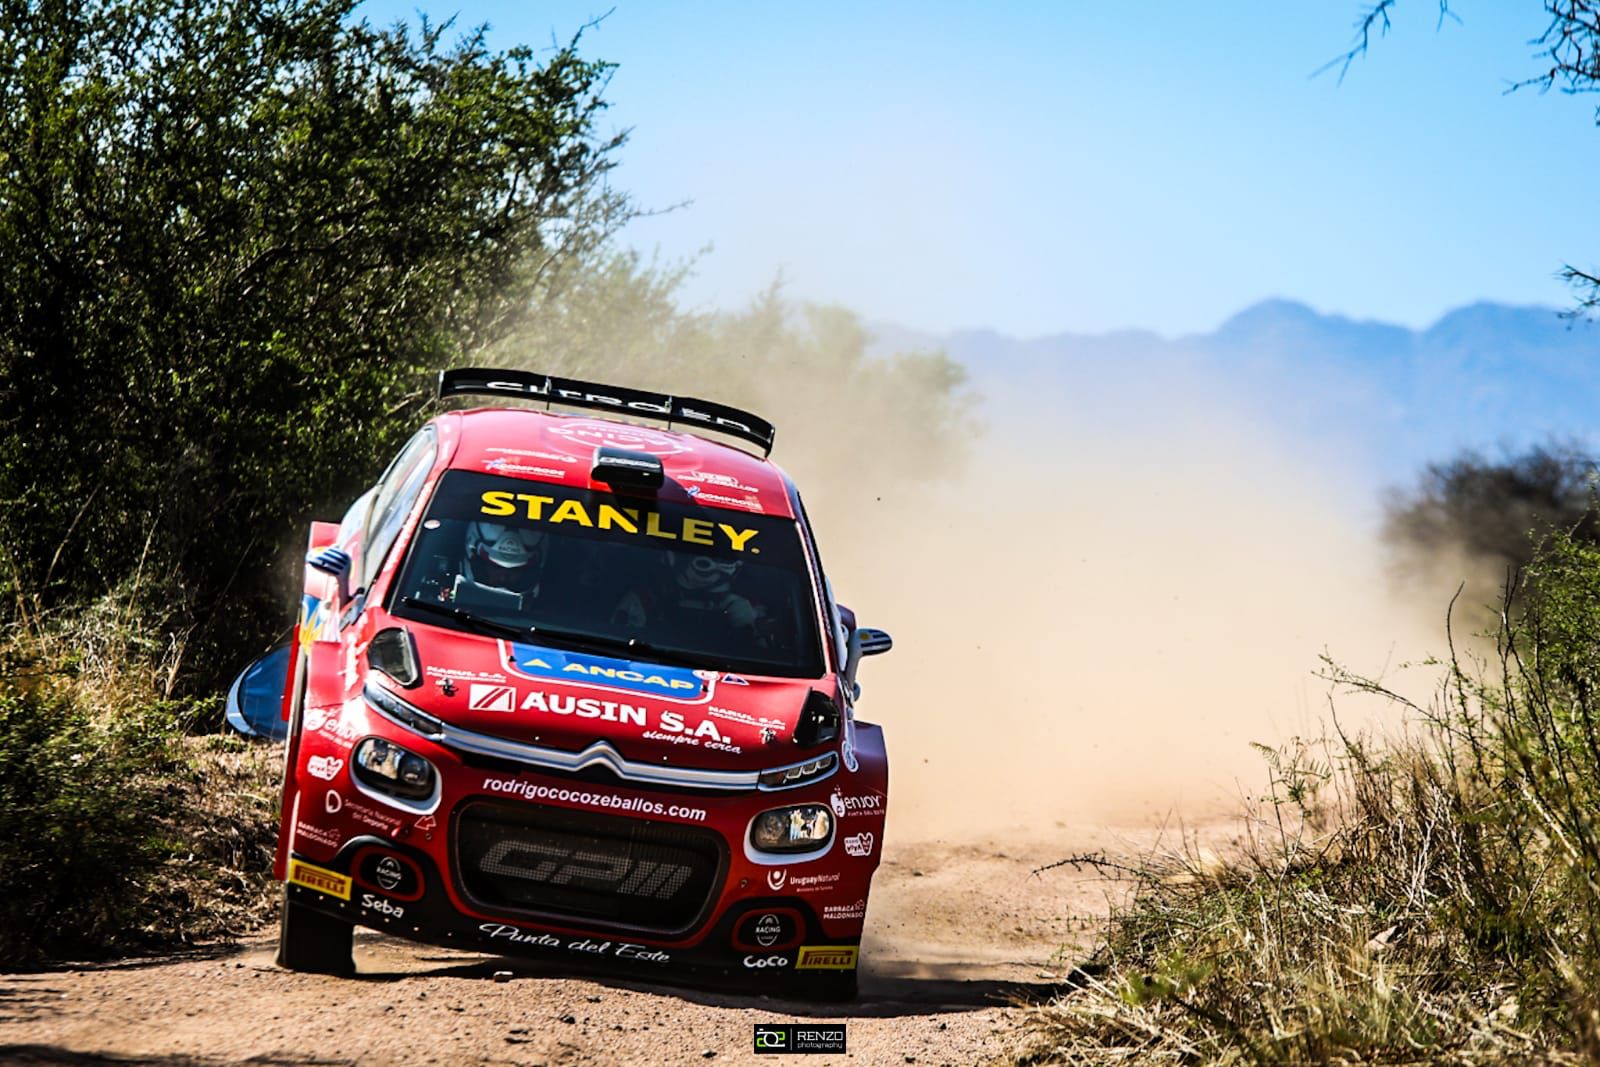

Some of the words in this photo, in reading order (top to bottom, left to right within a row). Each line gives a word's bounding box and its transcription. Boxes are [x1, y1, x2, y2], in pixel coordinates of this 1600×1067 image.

[562, 662, 695, 690] ANCAP
[520, 691, 647, 726] AUSIN
[659, 711, 732, 744] S.A.
[642, 730, 699, 746] siempre
[704, 740, 742, 755] cerca
[482, 777, 707, 822] rodrigococozeballos.com
[293, 864, 347, 895] PIRELLI
[361, 893, 405, 918] Seba
[822, 912, 864, 920] MALDONADO
[823, 905, 855, 913] BARRACA
[755, 926, 781, 934] RACING
[479, 923, 562, 948] Punta
[568, 938, 610, 954] del
[614, 942, 672, 964] Este
[801, 950, 854, 966] PIRELLI
